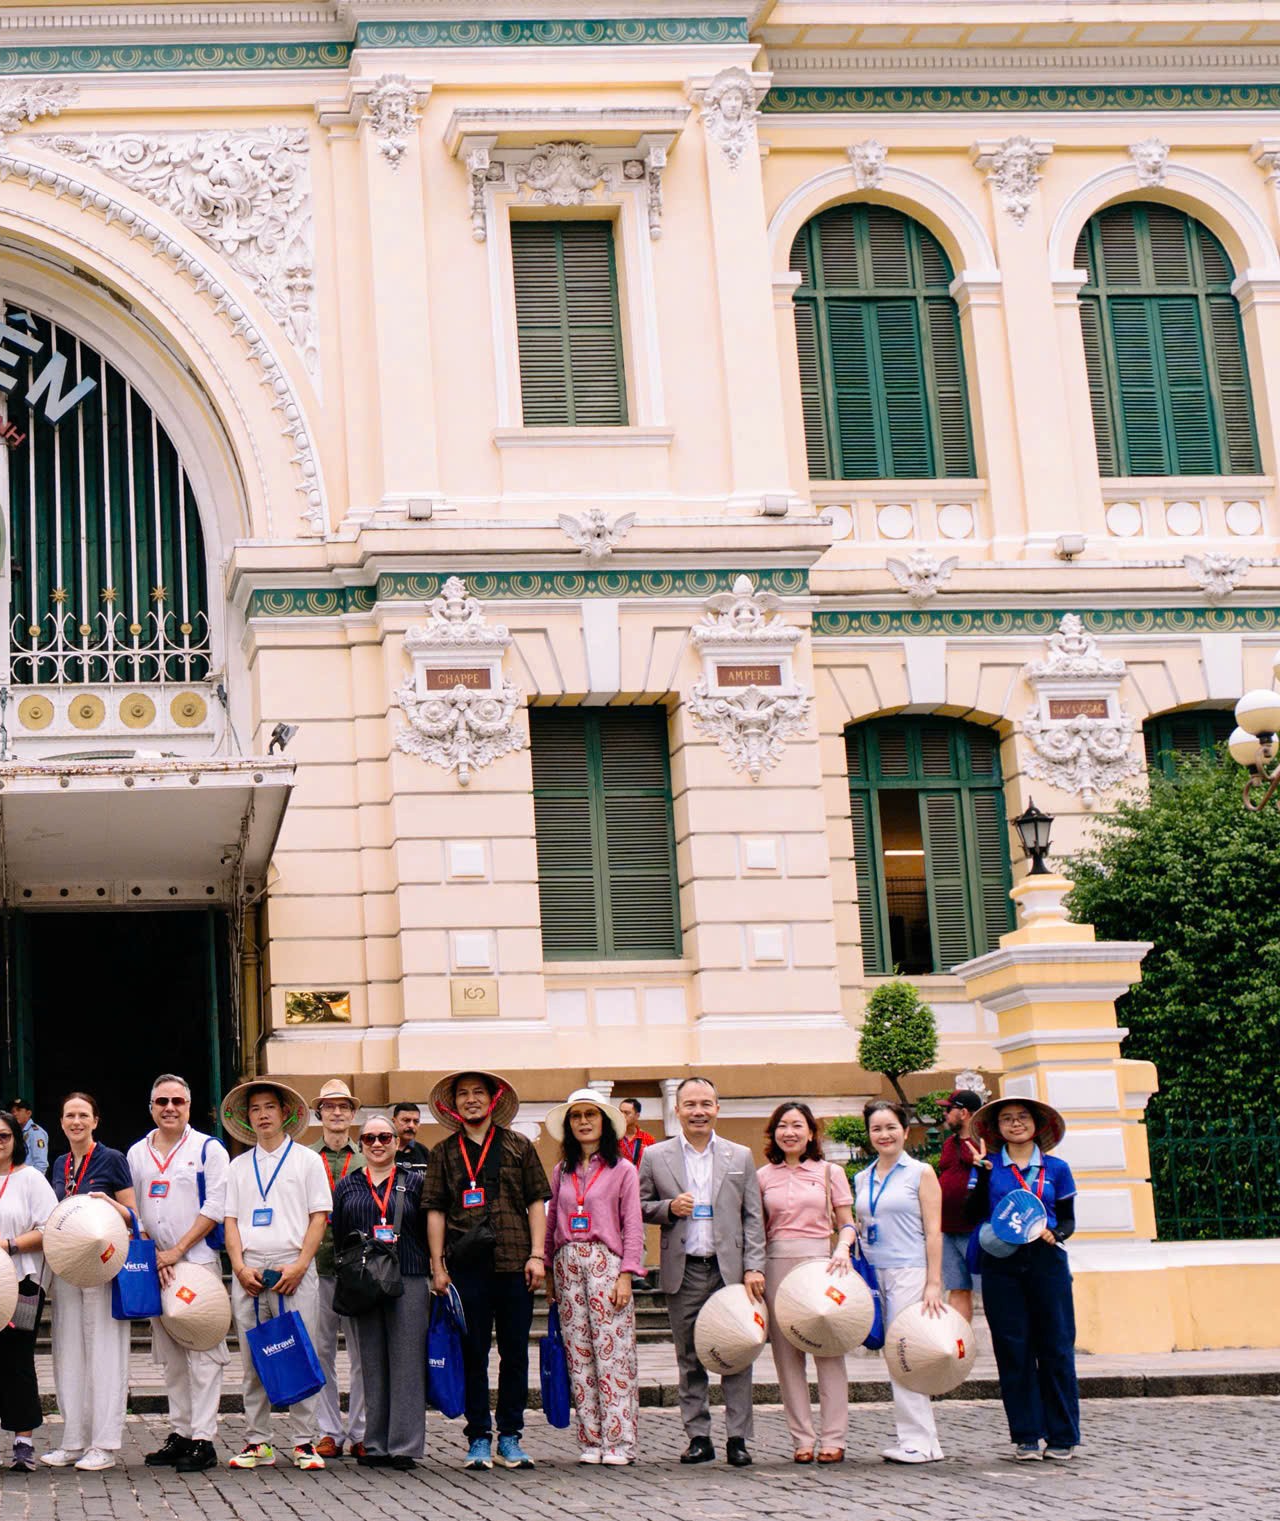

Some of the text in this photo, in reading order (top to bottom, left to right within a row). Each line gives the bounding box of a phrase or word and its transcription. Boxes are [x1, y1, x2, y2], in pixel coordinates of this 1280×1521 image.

[438, 673, 480, 684] CHAPPE
[728, 670, 770, 681] AMPERE
[262, 1334, 295, 1356] Vietravel
